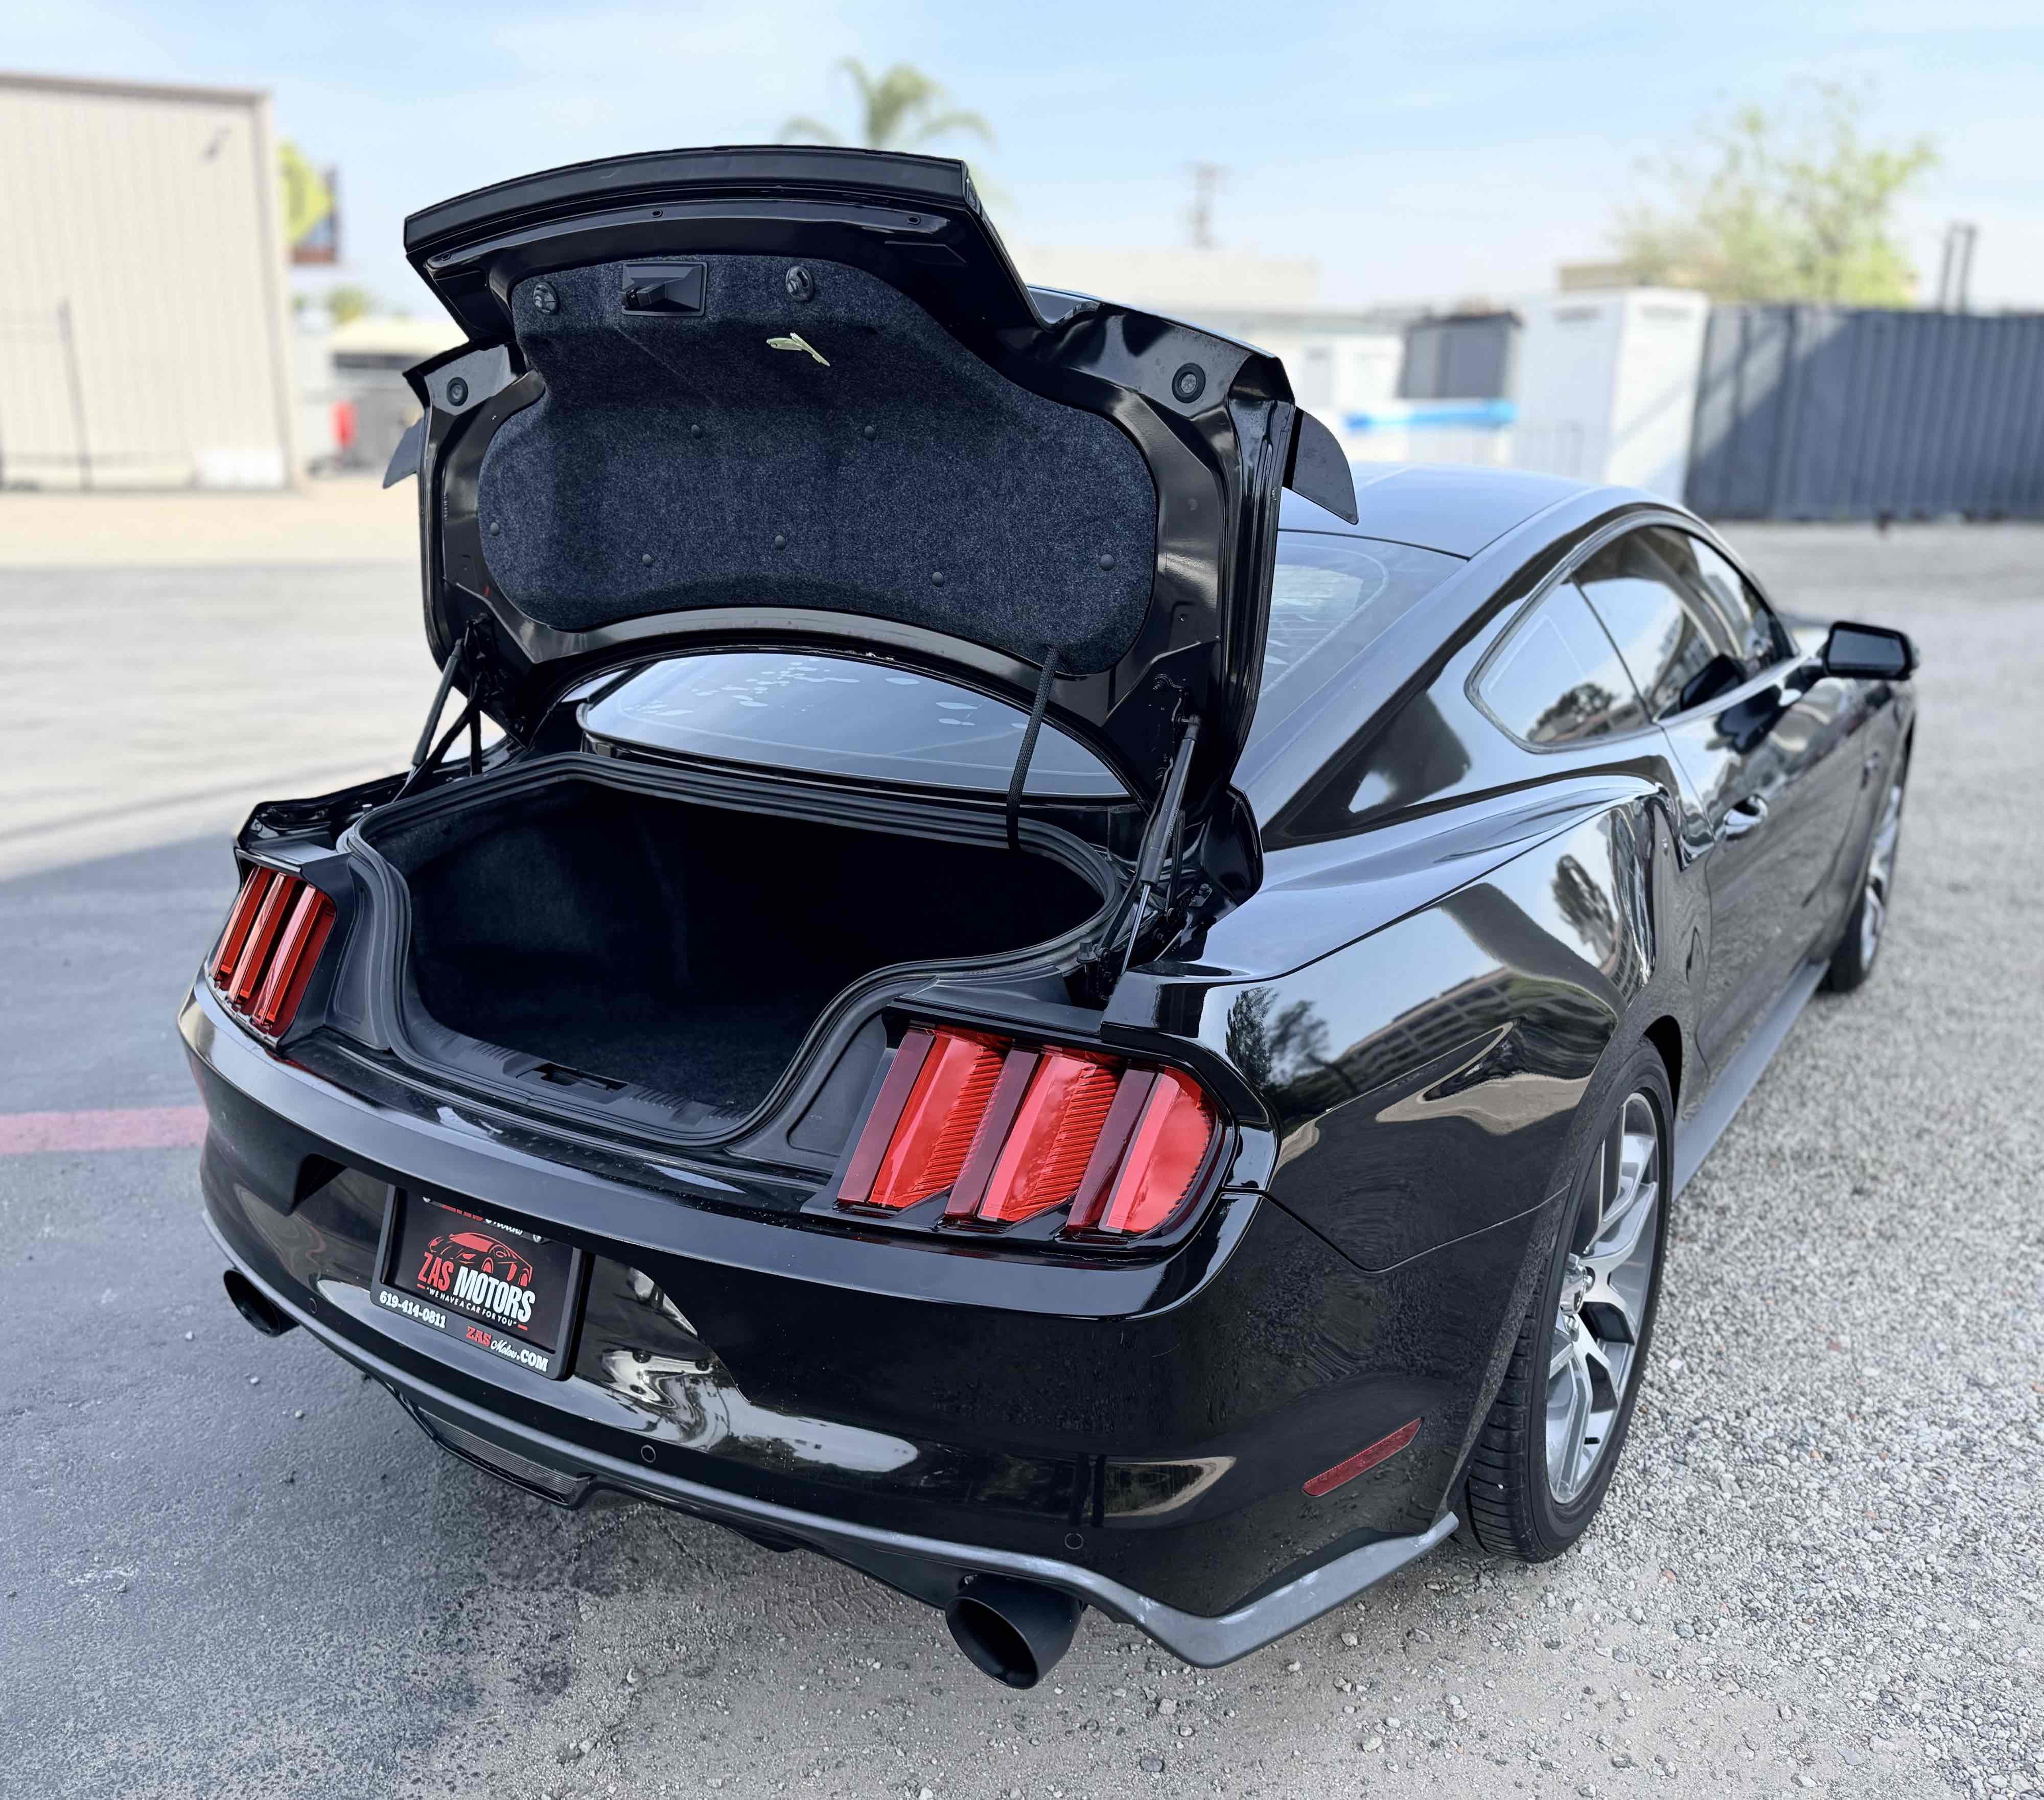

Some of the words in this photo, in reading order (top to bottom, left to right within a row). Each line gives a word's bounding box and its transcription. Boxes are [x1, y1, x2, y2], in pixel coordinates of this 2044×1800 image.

[417, 1252, 454, 1291] ZAS
[453, 1266, 536, 1322] MOTORS
[380, 1291, 446, 1328] 619-414-0811
[440, 1292, 459, 1305] HAVE
[466, 1302, 480, 1314] CAR
[482, 1308, 496, 1320] FOR
